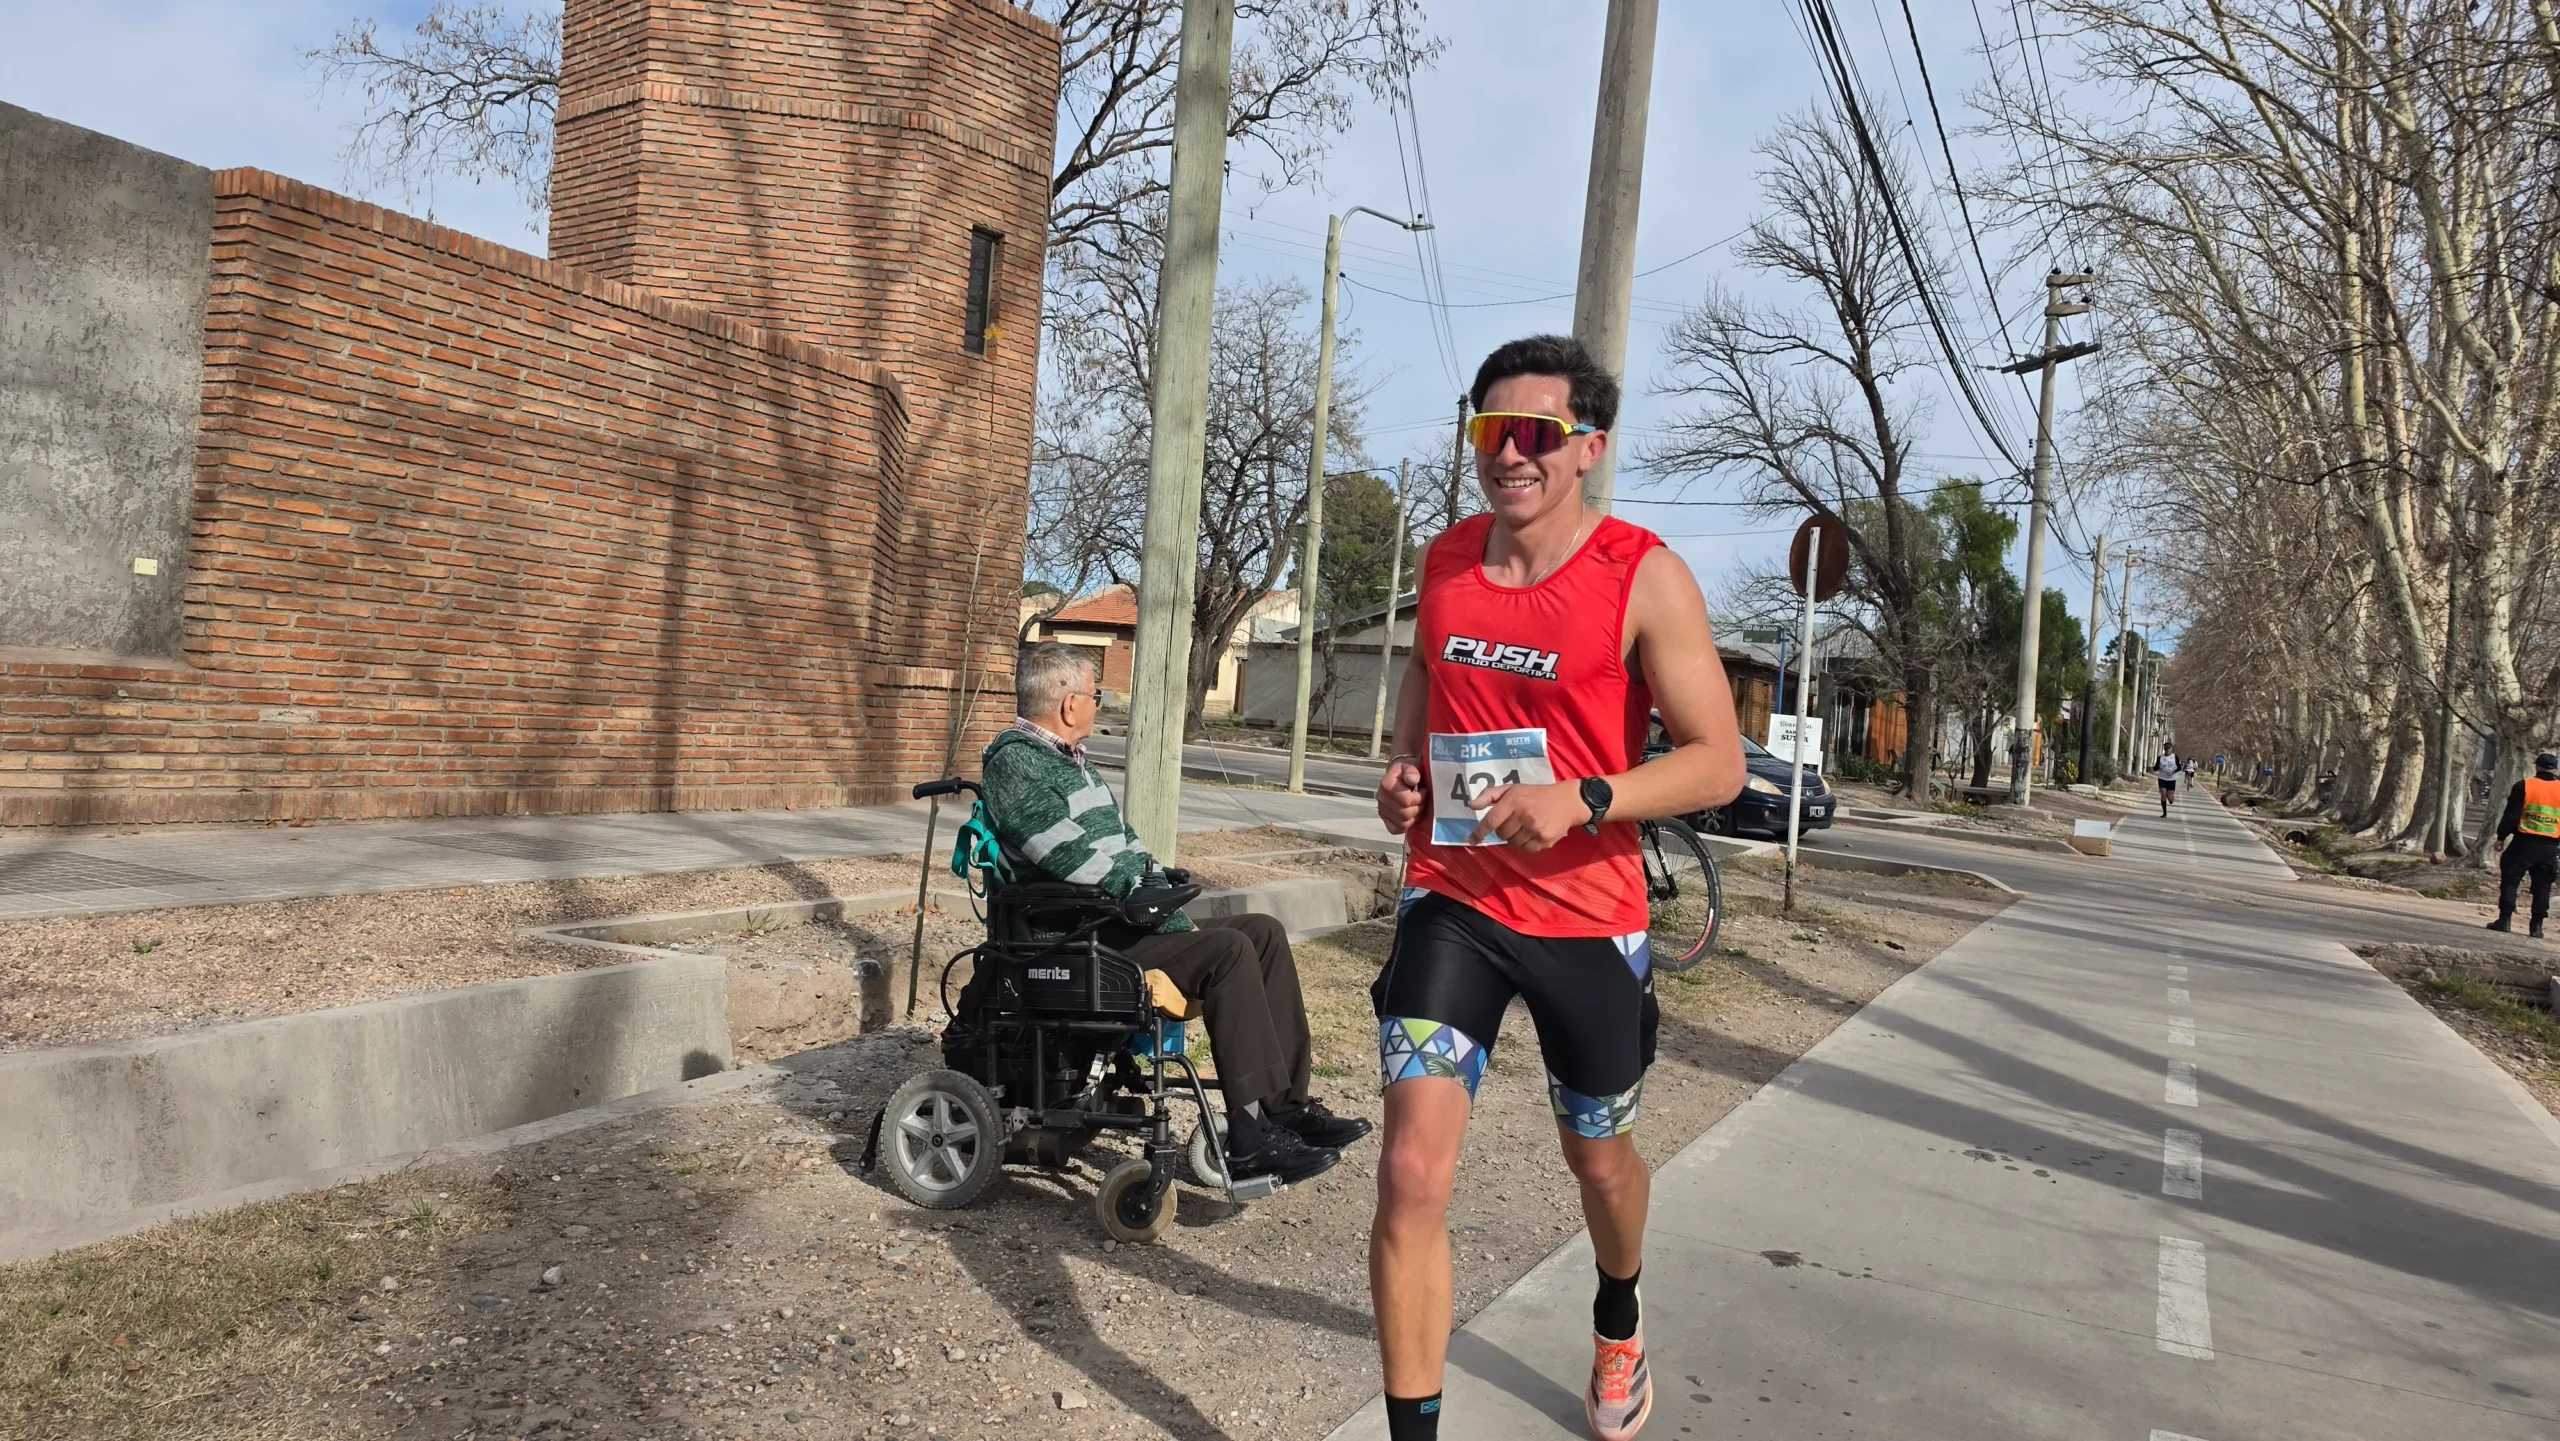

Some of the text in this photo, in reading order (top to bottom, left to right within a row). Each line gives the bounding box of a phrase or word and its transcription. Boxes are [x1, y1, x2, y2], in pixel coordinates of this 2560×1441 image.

[1443, 635, 1559, 672] PUSH
[1443, 653, 1556, 680] ACTITUD DEPORTIVA
[1780, 734, 1809, 743] SUTR
[1460, 742, 1493, 759] 21K
[1028, 966, 1070, 980] merits
